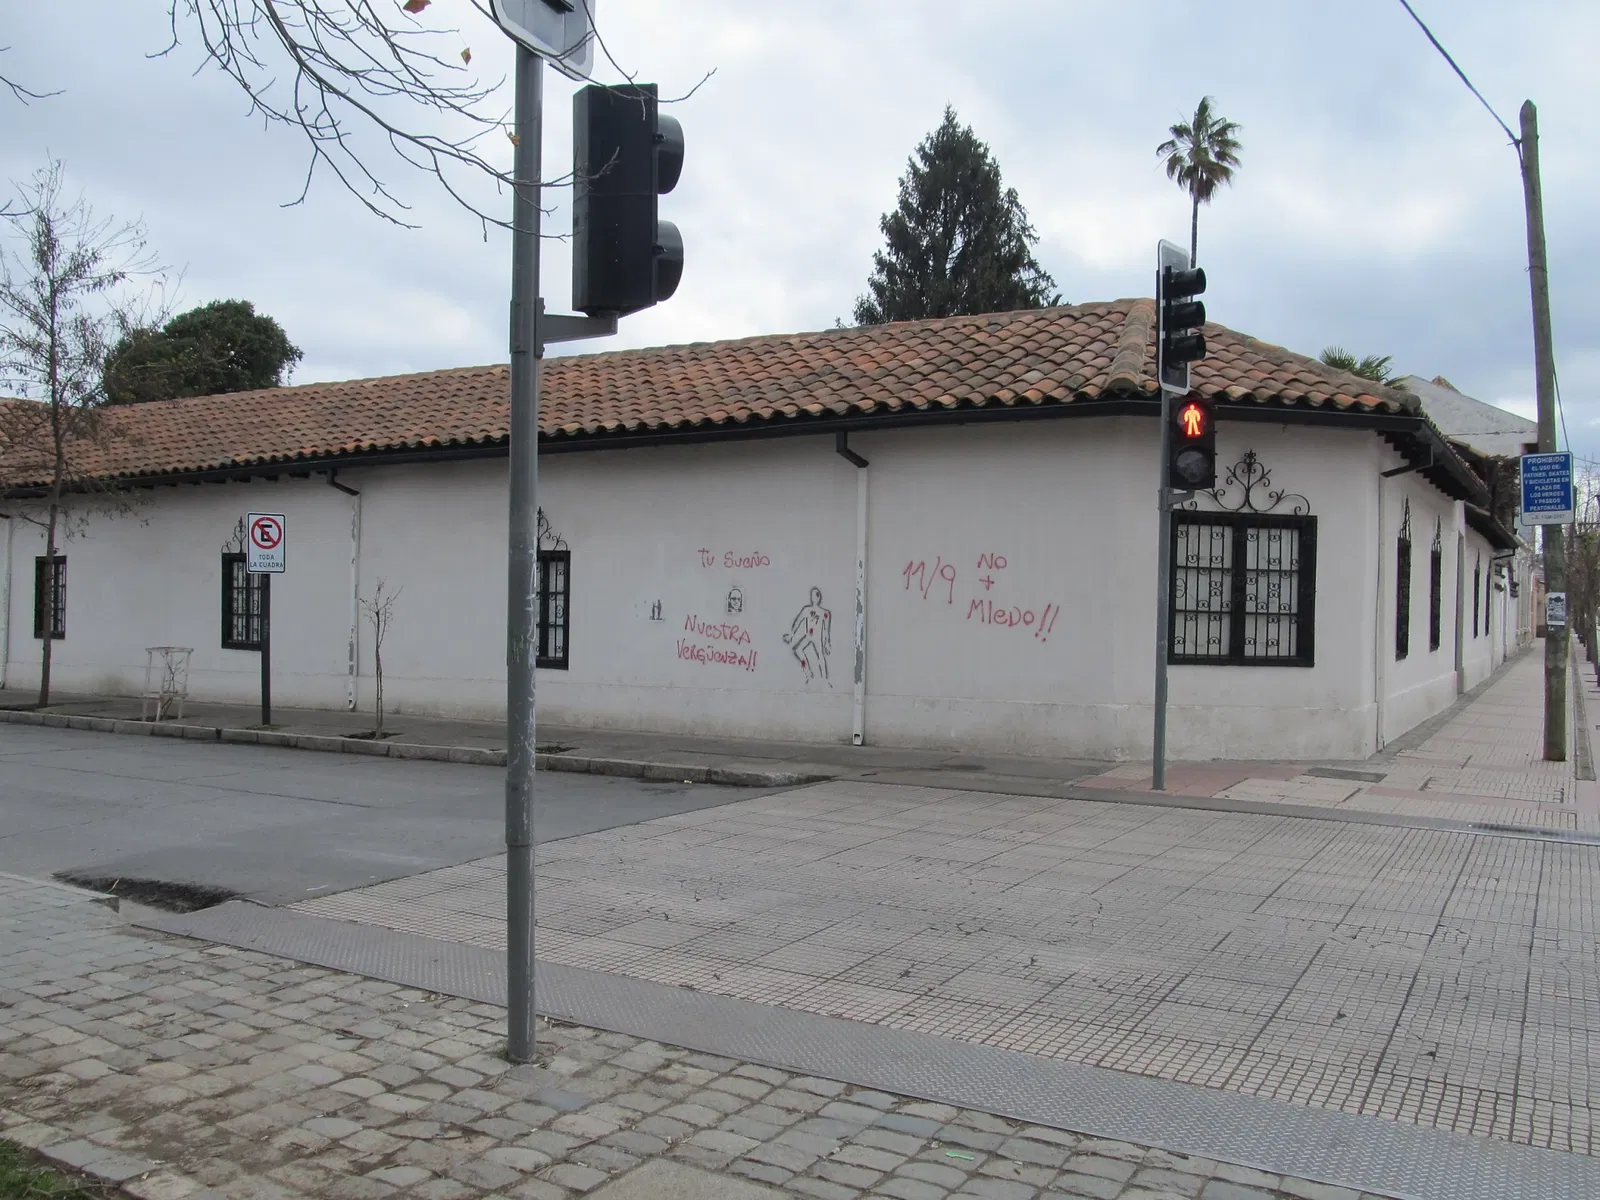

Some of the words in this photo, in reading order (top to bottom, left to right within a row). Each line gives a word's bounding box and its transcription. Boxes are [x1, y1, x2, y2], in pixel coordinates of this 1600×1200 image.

[1527, 456, 1565, 464] PROHIBIDO
[902, 556, 957, 605] 11/9
[978, 575, 995, 591] +
